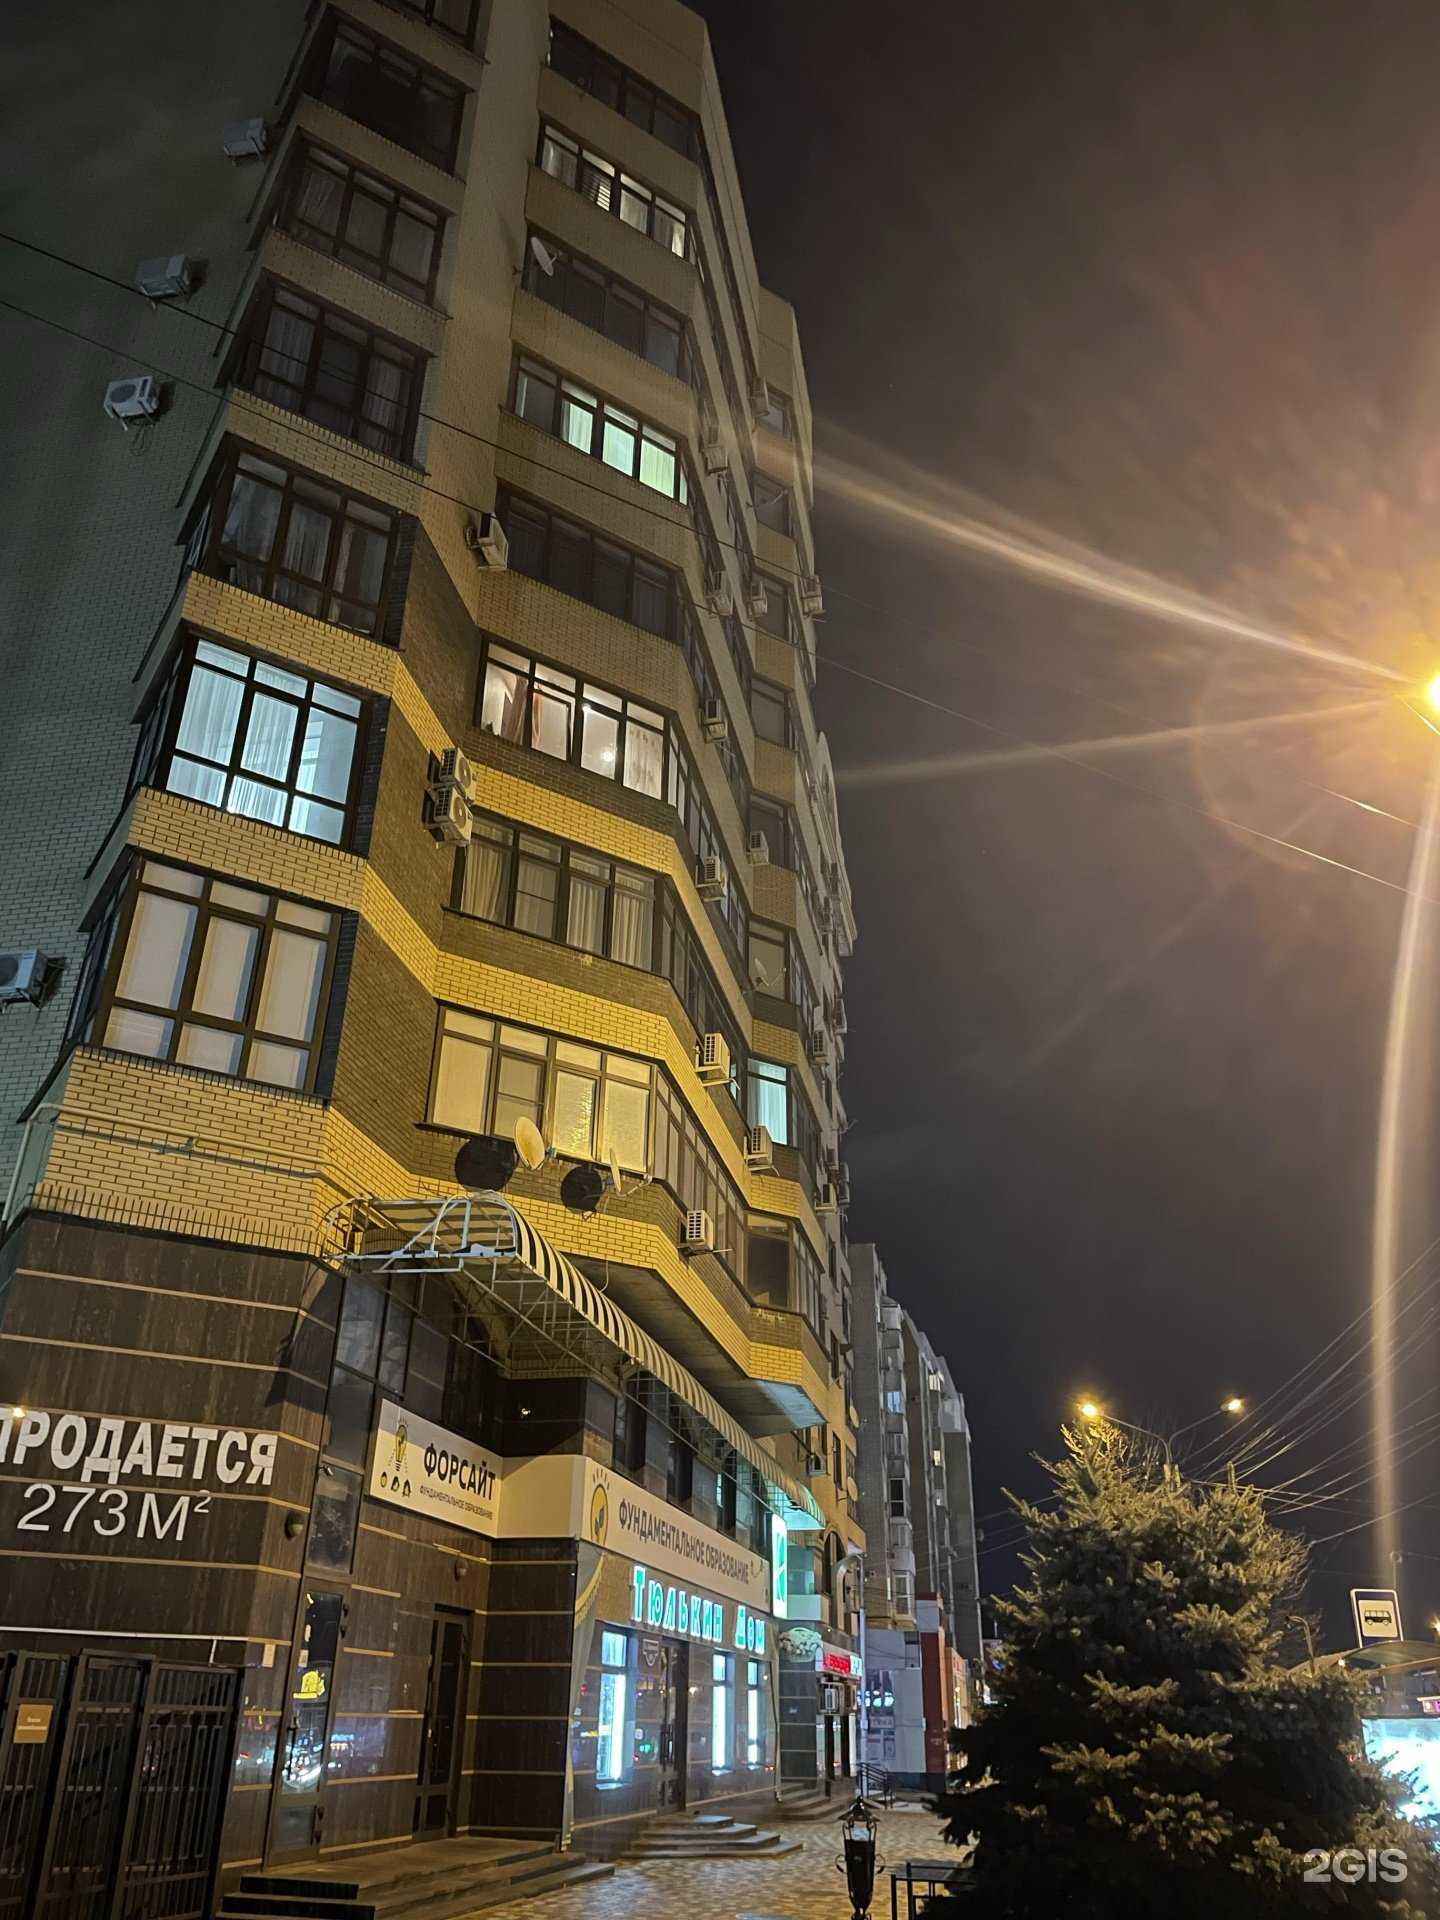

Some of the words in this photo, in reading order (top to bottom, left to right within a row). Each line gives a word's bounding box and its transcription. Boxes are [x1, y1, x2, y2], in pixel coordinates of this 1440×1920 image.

[424, 1443, 496, 1500] ФОРСАЙТ
[618, 1498, 705, 1563] ФУНДАМЕНТАЛЬНОЕ
[705, 1544, 749, 1585] ОБРАЗОВАНИЕ
